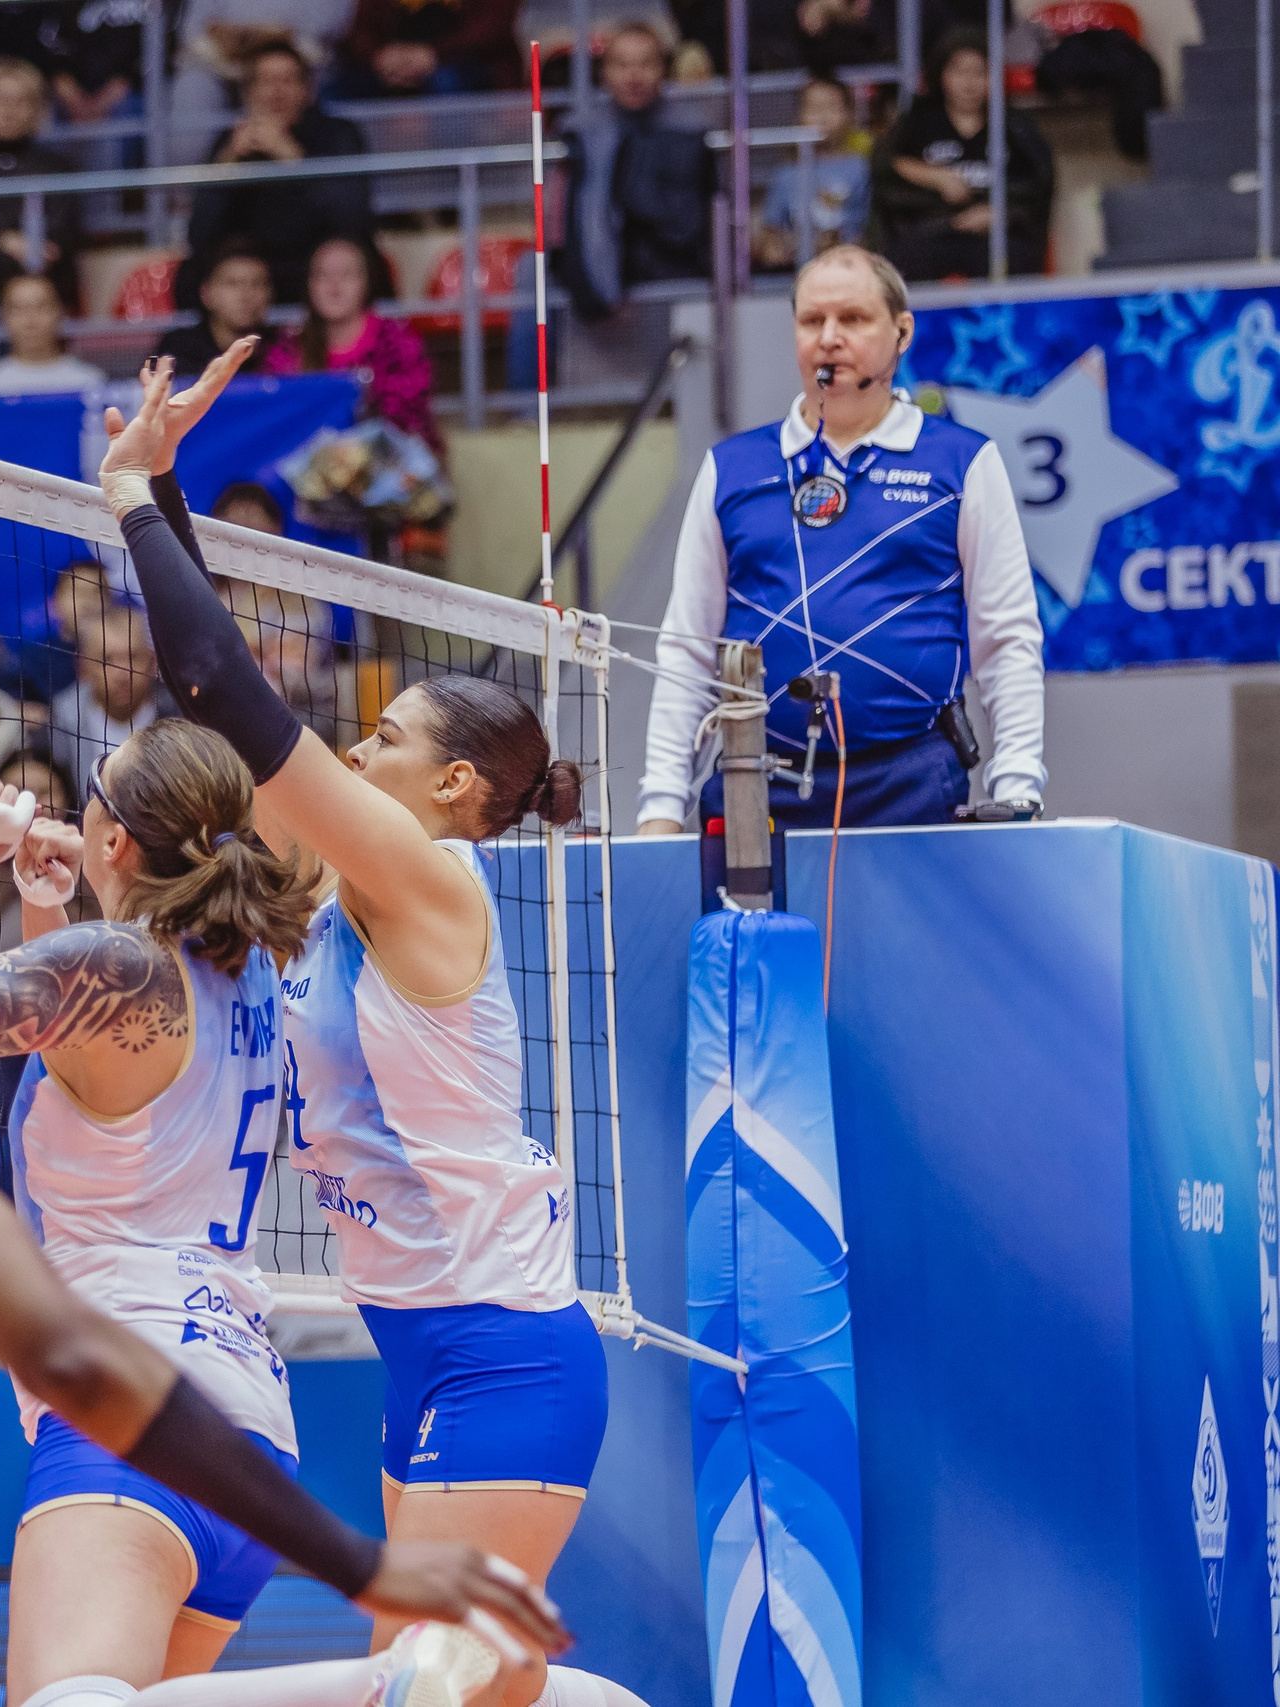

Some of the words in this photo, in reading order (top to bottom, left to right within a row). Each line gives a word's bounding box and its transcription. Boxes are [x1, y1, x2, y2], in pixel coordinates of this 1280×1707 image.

[887, 468, 932, 486] ВФВ
[1022, 435, 1067, 505] 3
[883, 488, 929, 504] СУДЬЯ
[1119, 540, 1280, 612] СЕКТ
[208, 1084, 276, 1252] 5
[1192, 1180, 1224, 1234] ВФВ
[177, 1252, 192, 1263] Ак
[194, 1253, 217, 1265] Бар
[178, 1265, 204, 1277] Банк
[419, 1407, 437, 1448] 4
